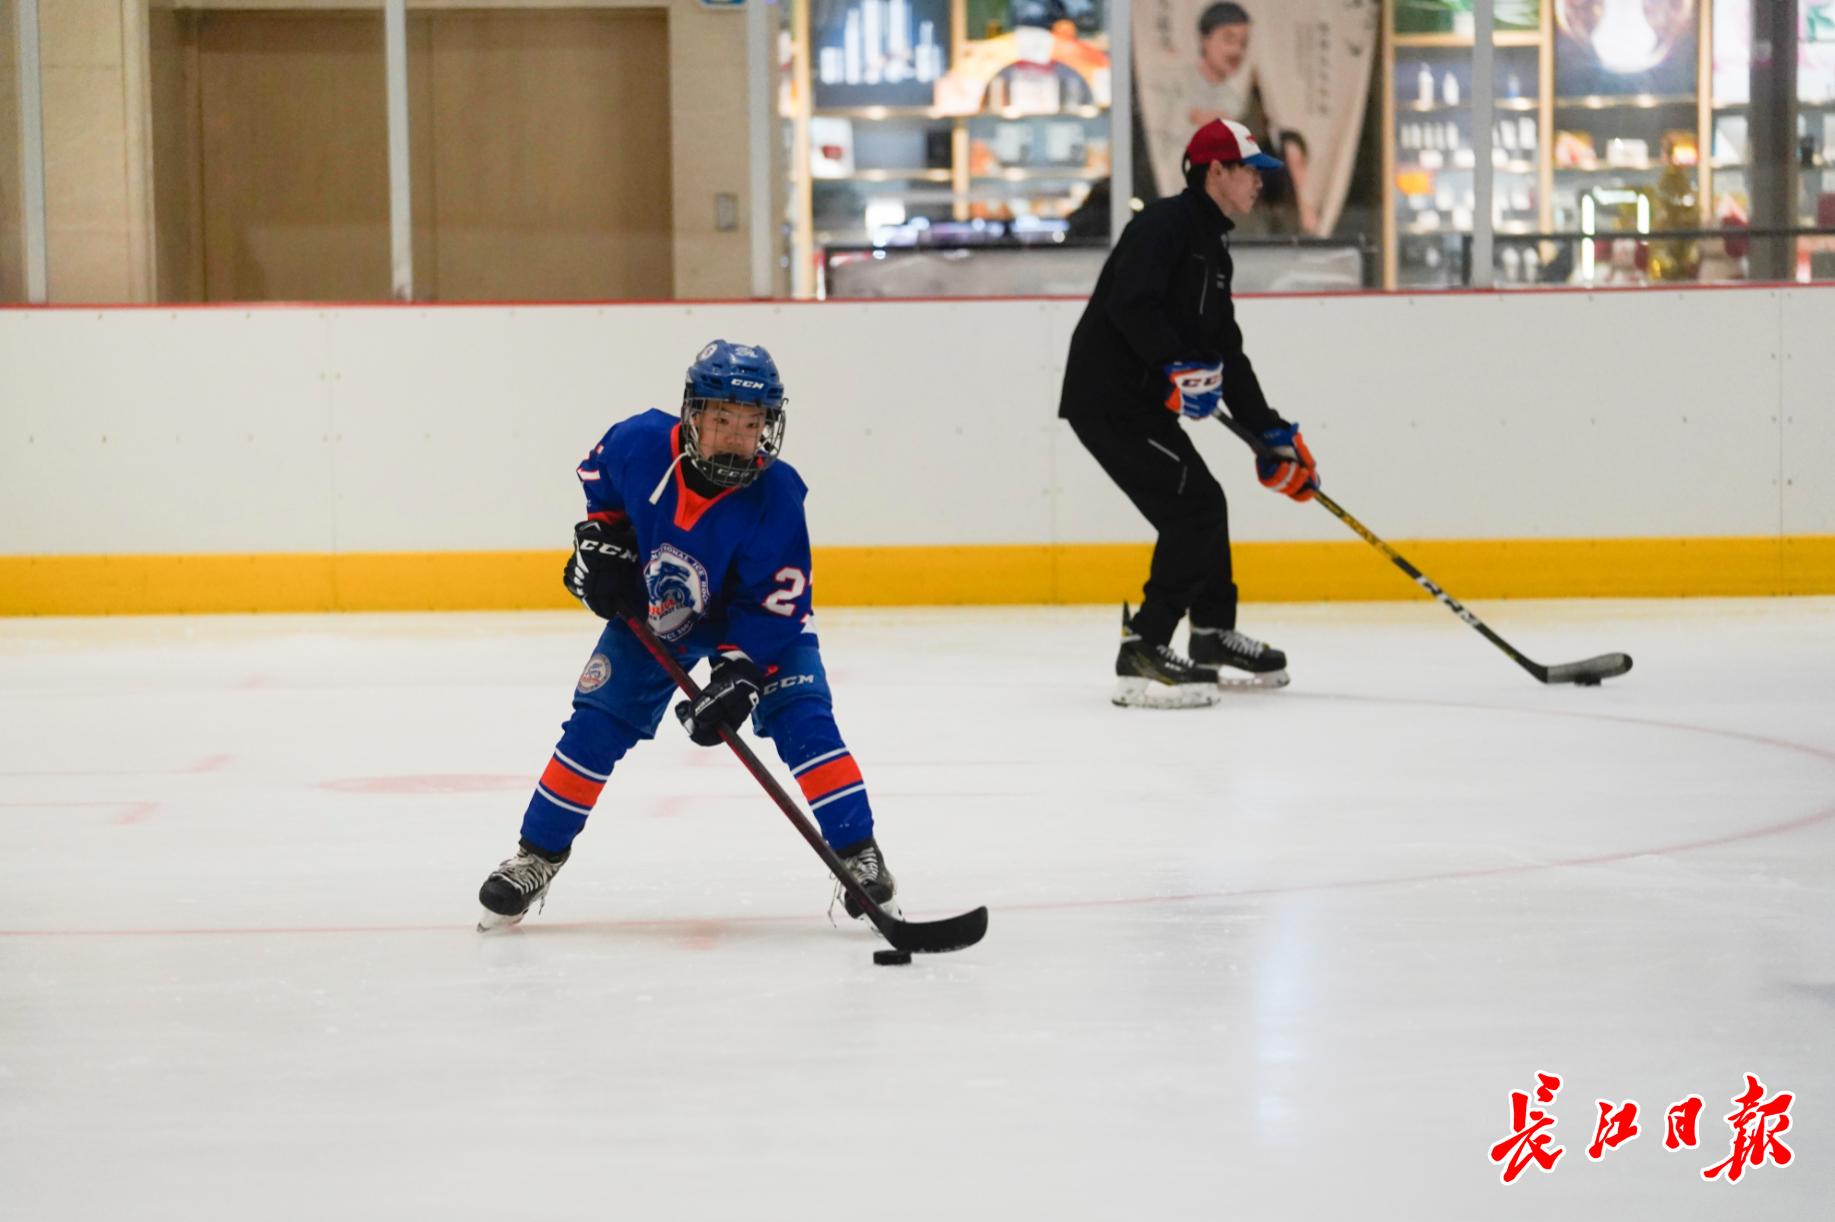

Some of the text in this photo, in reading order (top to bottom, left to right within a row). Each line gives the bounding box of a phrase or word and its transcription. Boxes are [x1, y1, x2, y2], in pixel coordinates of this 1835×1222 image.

[731, 378, 764, 390] CCM
[580, 539, 638, 563] CCM
[763, 674, 814, 696] CCM
